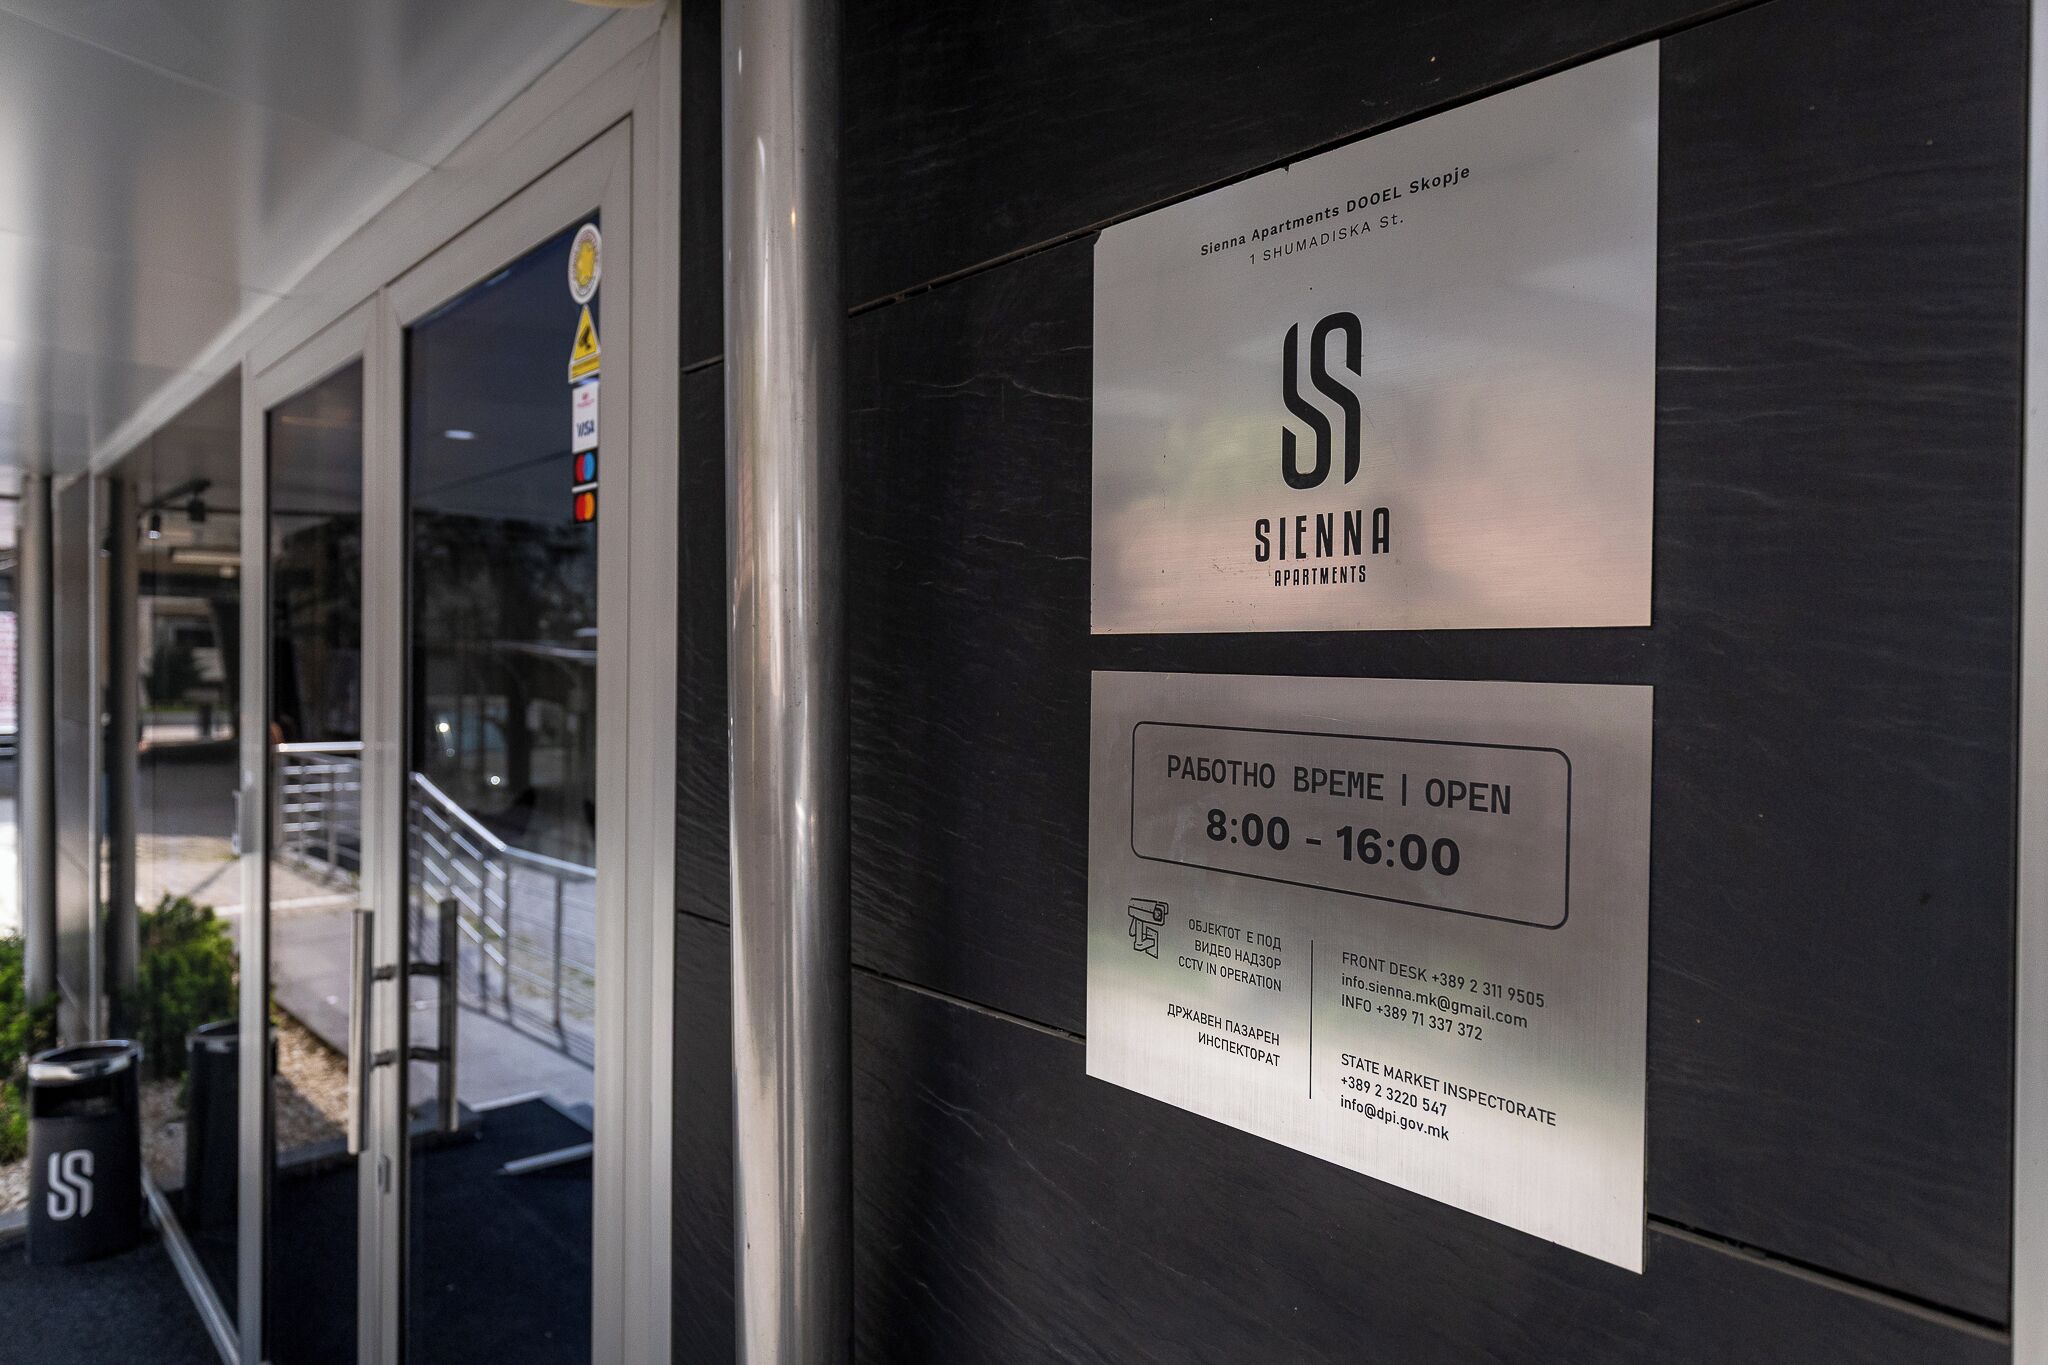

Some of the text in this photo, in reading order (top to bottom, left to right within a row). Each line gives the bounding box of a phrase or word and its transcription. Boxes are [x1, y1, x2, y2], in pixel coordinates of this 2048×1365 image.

[1201, 166, 1470, 256] Sienna Apartments DOOEL Skopje
[1250, 213, 1403, 264] 1 SHUMADISKA St.
[577, 420, 595, 437] VISA
[1255, 507, 1390, 562] SIENNA
[1274, 565, 1366, 586] APARTMENTS
[1168, 754, 1275, 789] РАБОТНО
[1294, 766, 1384, 800] ВРЕМЕ
[1425, 778, 1511, 814] OPEN
[1206, 808, 1289, 850] 8:00
[1336, 826, 1460, 876] 16:00
[1189, 919, 1241, 940] ОБЈЕКТОТ
[1257, 933, 1281, 951] ПОД
[1195, 940, 1281, 969] ВИДЕО НАДЗОР
[1178, 956, 1281, 991] CCTV IN OPERATION
[1342, 952, 1544, 1008] FRONT DESK +389 2 311 9505
[1342, 973, 1528, 1028] info.sienna.mk@gmail.com
[1342, 994, 1483, 1040] INFO +389 71 337 372
[1168, 1003, 1280, 1046] ДРЖАВЕН ПАЗАРЕН
[1199, 1032, 1280, 1066] ИНСПЕКТОРАТ
[1341, 1054, 1556, 1126] STATE MARKET INSPECTORATE
[1341, 1076, 1447, 1116] +389 2 3220 547
[1341, 1095, 1449, 1140] info@dpi.gov.mk
